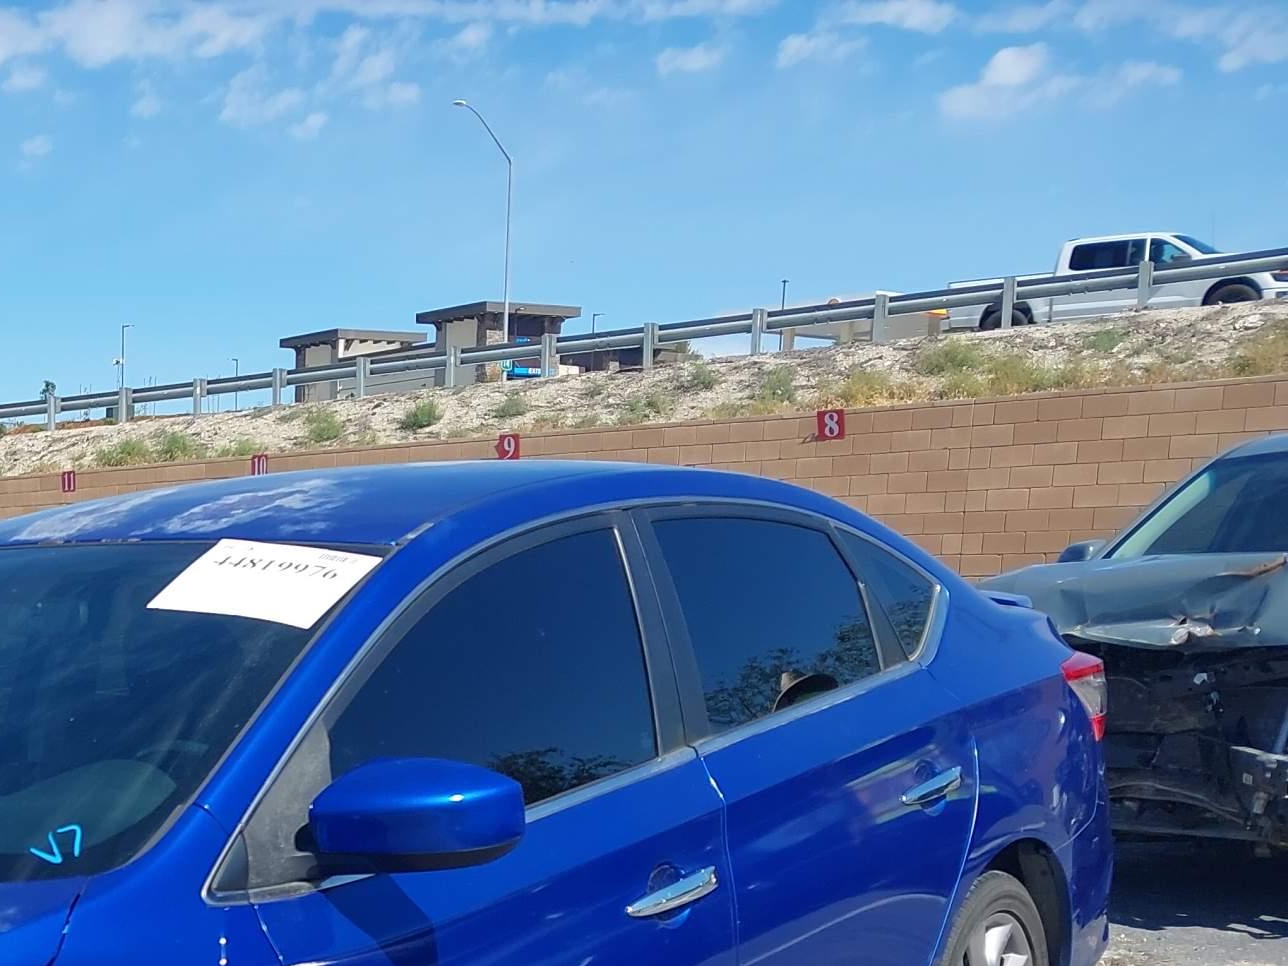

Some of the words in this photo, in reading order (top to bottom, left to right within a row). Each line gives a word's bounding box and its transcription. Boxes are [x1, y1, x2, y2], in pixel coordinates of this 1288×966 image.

[824, 412, 839, 437] 8
[503, 436, 515, 459] 9
[65, 472, 73, 490] 11
[213, 556, 337, 579] 44819976
